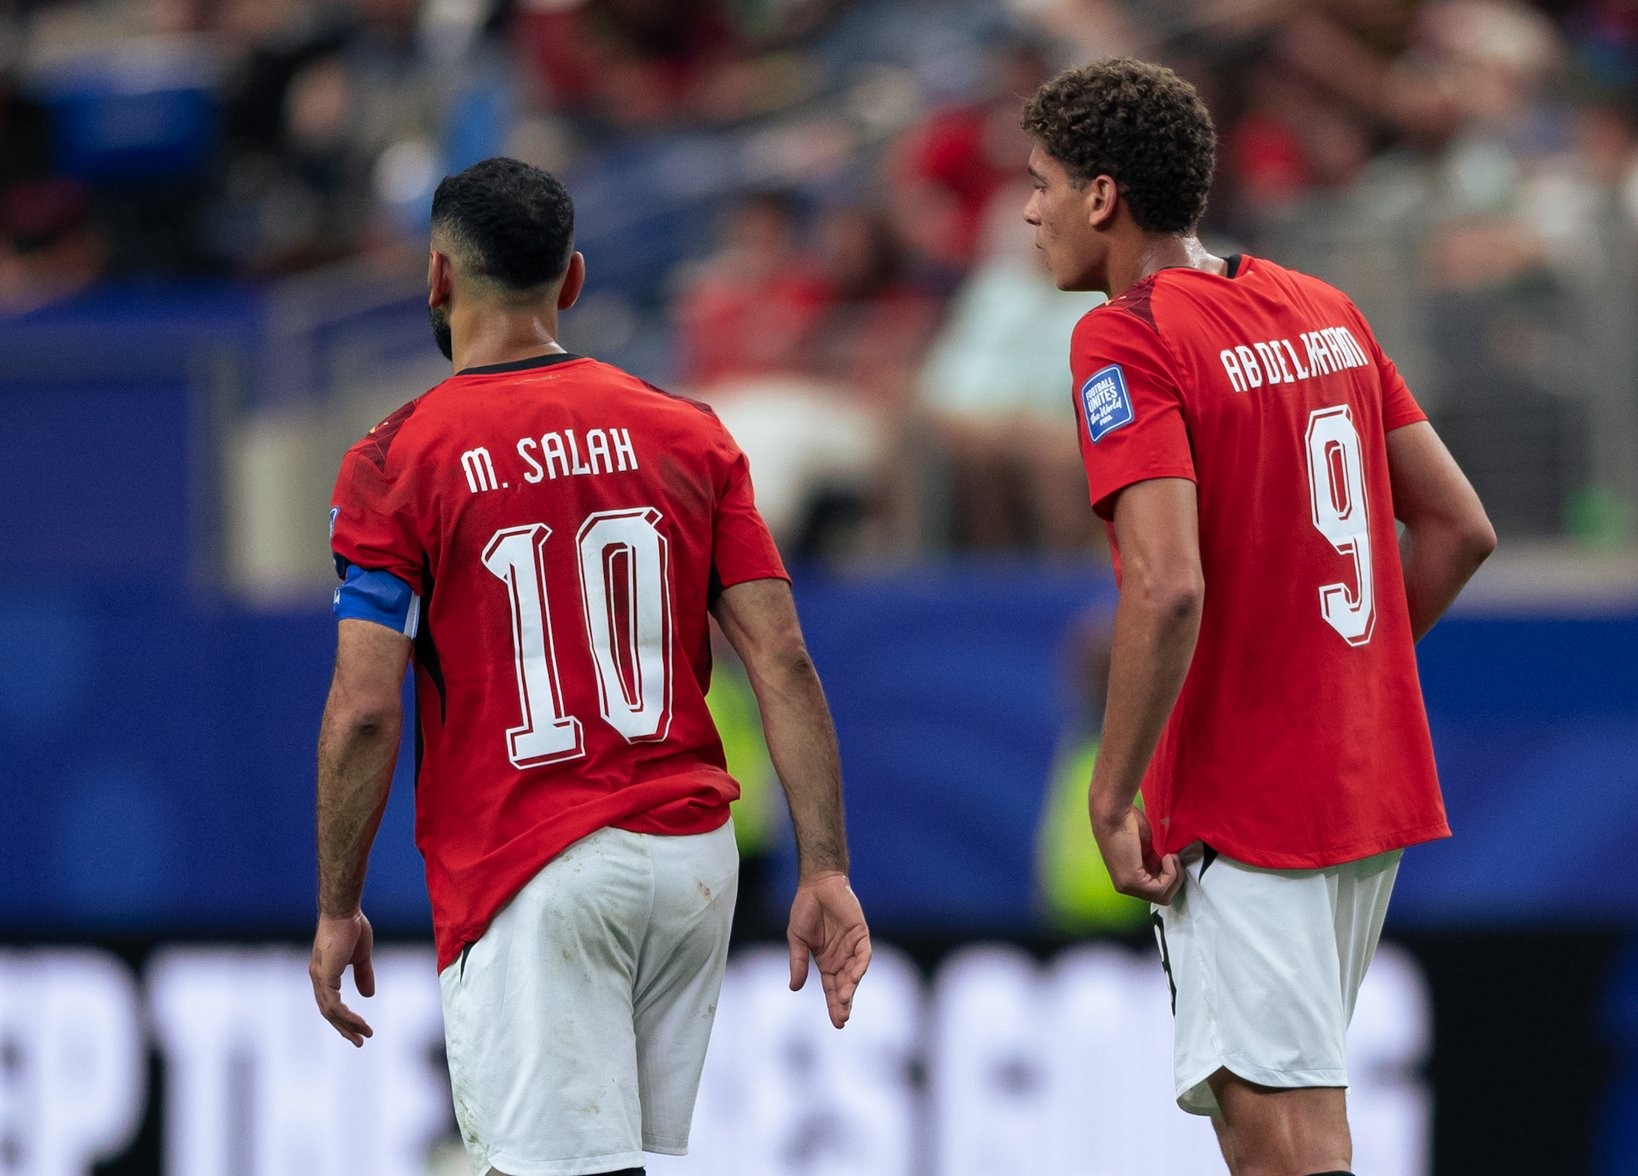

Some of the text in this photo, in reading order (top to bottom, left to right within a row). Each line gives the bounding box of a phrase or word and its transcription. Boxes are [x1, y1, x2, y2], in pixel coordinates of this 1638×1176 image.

[1085, 376, 1114, 399] FOOTBALL
[1087, 385, 1117, 412] UNITES
[1099, 396, 1122, 417] World
[461, 428, 638, 493] M. SALAH
[1304, 403, 1376, 647] 9
[481, 506, 673, 770] 10
